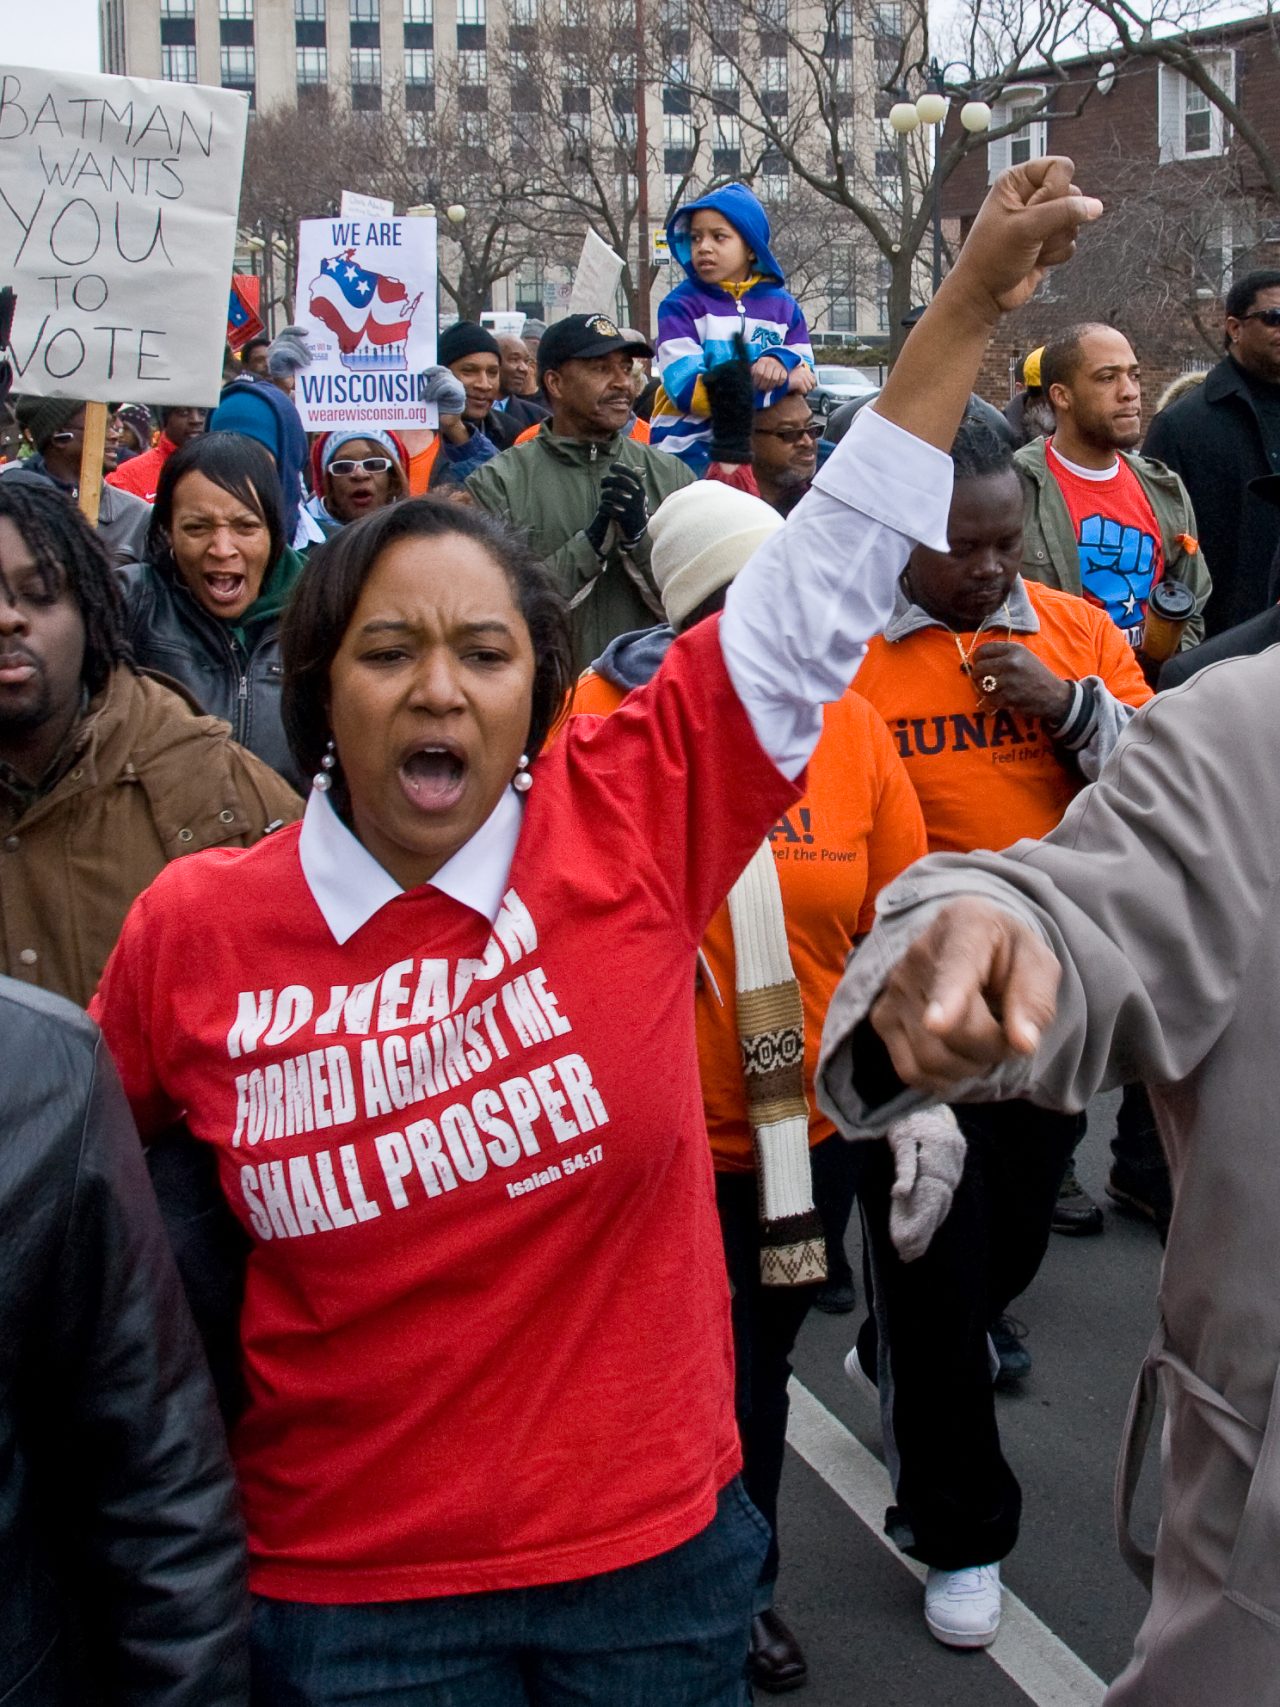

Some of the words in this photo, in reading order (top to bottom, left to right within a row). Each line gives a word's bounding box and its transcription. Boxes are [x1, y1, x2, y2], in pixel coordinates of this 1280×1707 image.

[0, 75, 214, 157] BATMAN
[38, 145, 185, 200] WANTS
[0, 187, 175, 268] YOU
[332, 223, 361, 247] WE
[365, 222, 402, 247] ARE
[37, 274, 109, 312] TO
[6, 314, 171, 381] VOTE
[308, 403, 427, 423] wearewisconsin.org
[1018, 747, 1039, 761] the
[793, 848, 818, 861] the
[821, 848, 857, 862] Power
[227, 985, 314, 1059] NO
[232, 1045, 356, 1148] FORMED
[360, 994, 509, 1119] AGAINST
[502, 967, 573, 1049] ME
[240, 1143, 382, 1241] SHALL
[374, 1053, 611, 1211] PROSPER
[507, 1167, 562, 1199] Isaiah
[560, 1144, 604, 1181] 54:17
